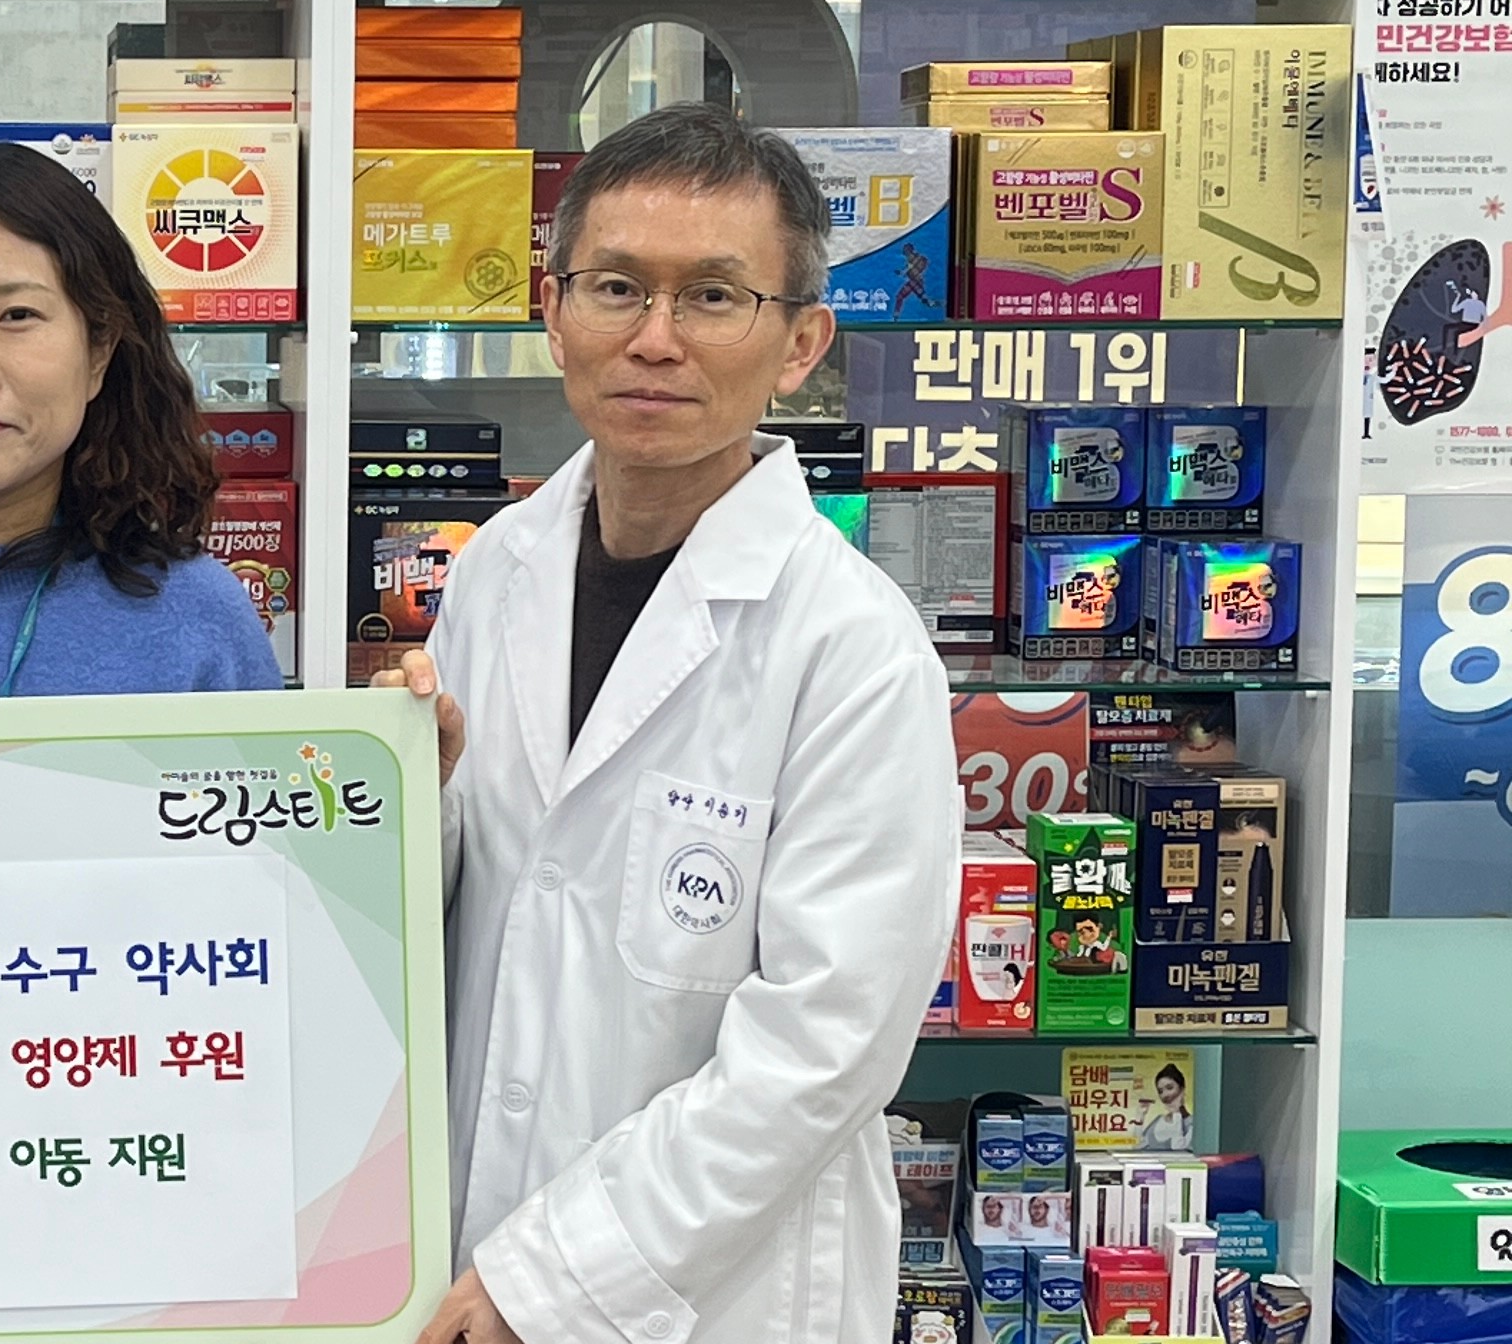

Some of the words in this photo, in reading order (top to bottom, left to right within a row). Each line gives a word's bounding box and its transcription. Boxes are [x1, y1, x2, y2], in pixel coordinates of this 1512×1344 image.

[1028, 107, 1045, 127] S
[867, 174, 915, 227] B
[995, 192, 1088, 221] 벤포벨
[1099, 167, 1144, 222] S
[152, 207, 252, 236] 씨큐맥스
[363, 223, 451, 246] 메가트루
[914, 329, 1046, 401] 판매
[1070, 332, 1167, 404] 1위
[1051, 449, 1109, 477] 비맥스
[1169, 446, 1228, 476] 비맥스
[1047, 576, 1104, 604] 비맥스
[1201, 585, 1261, 613] 비맥스
[203, 770, 221, 782] 꿈을
[158, 764, 383, 846] 드림스타트
[1151, 809, 1215, 831] 미녹펜겔
[677, 871, 725, 905] KPA
[125, 937, 269, 996] 약사회
[1168, 962, 1260, 993] 미녹펜겔
[11, 1033, 137, 1089] 영양제
[160, 1030, 245, 1081] 후원
[1069, 1064, 1110, 1085] 담배
[1068, 1089, 1129, 1109] 피우지
[9, 1136, 92, 1187] 아동
[107, 1133, 187, 1182] 지원
